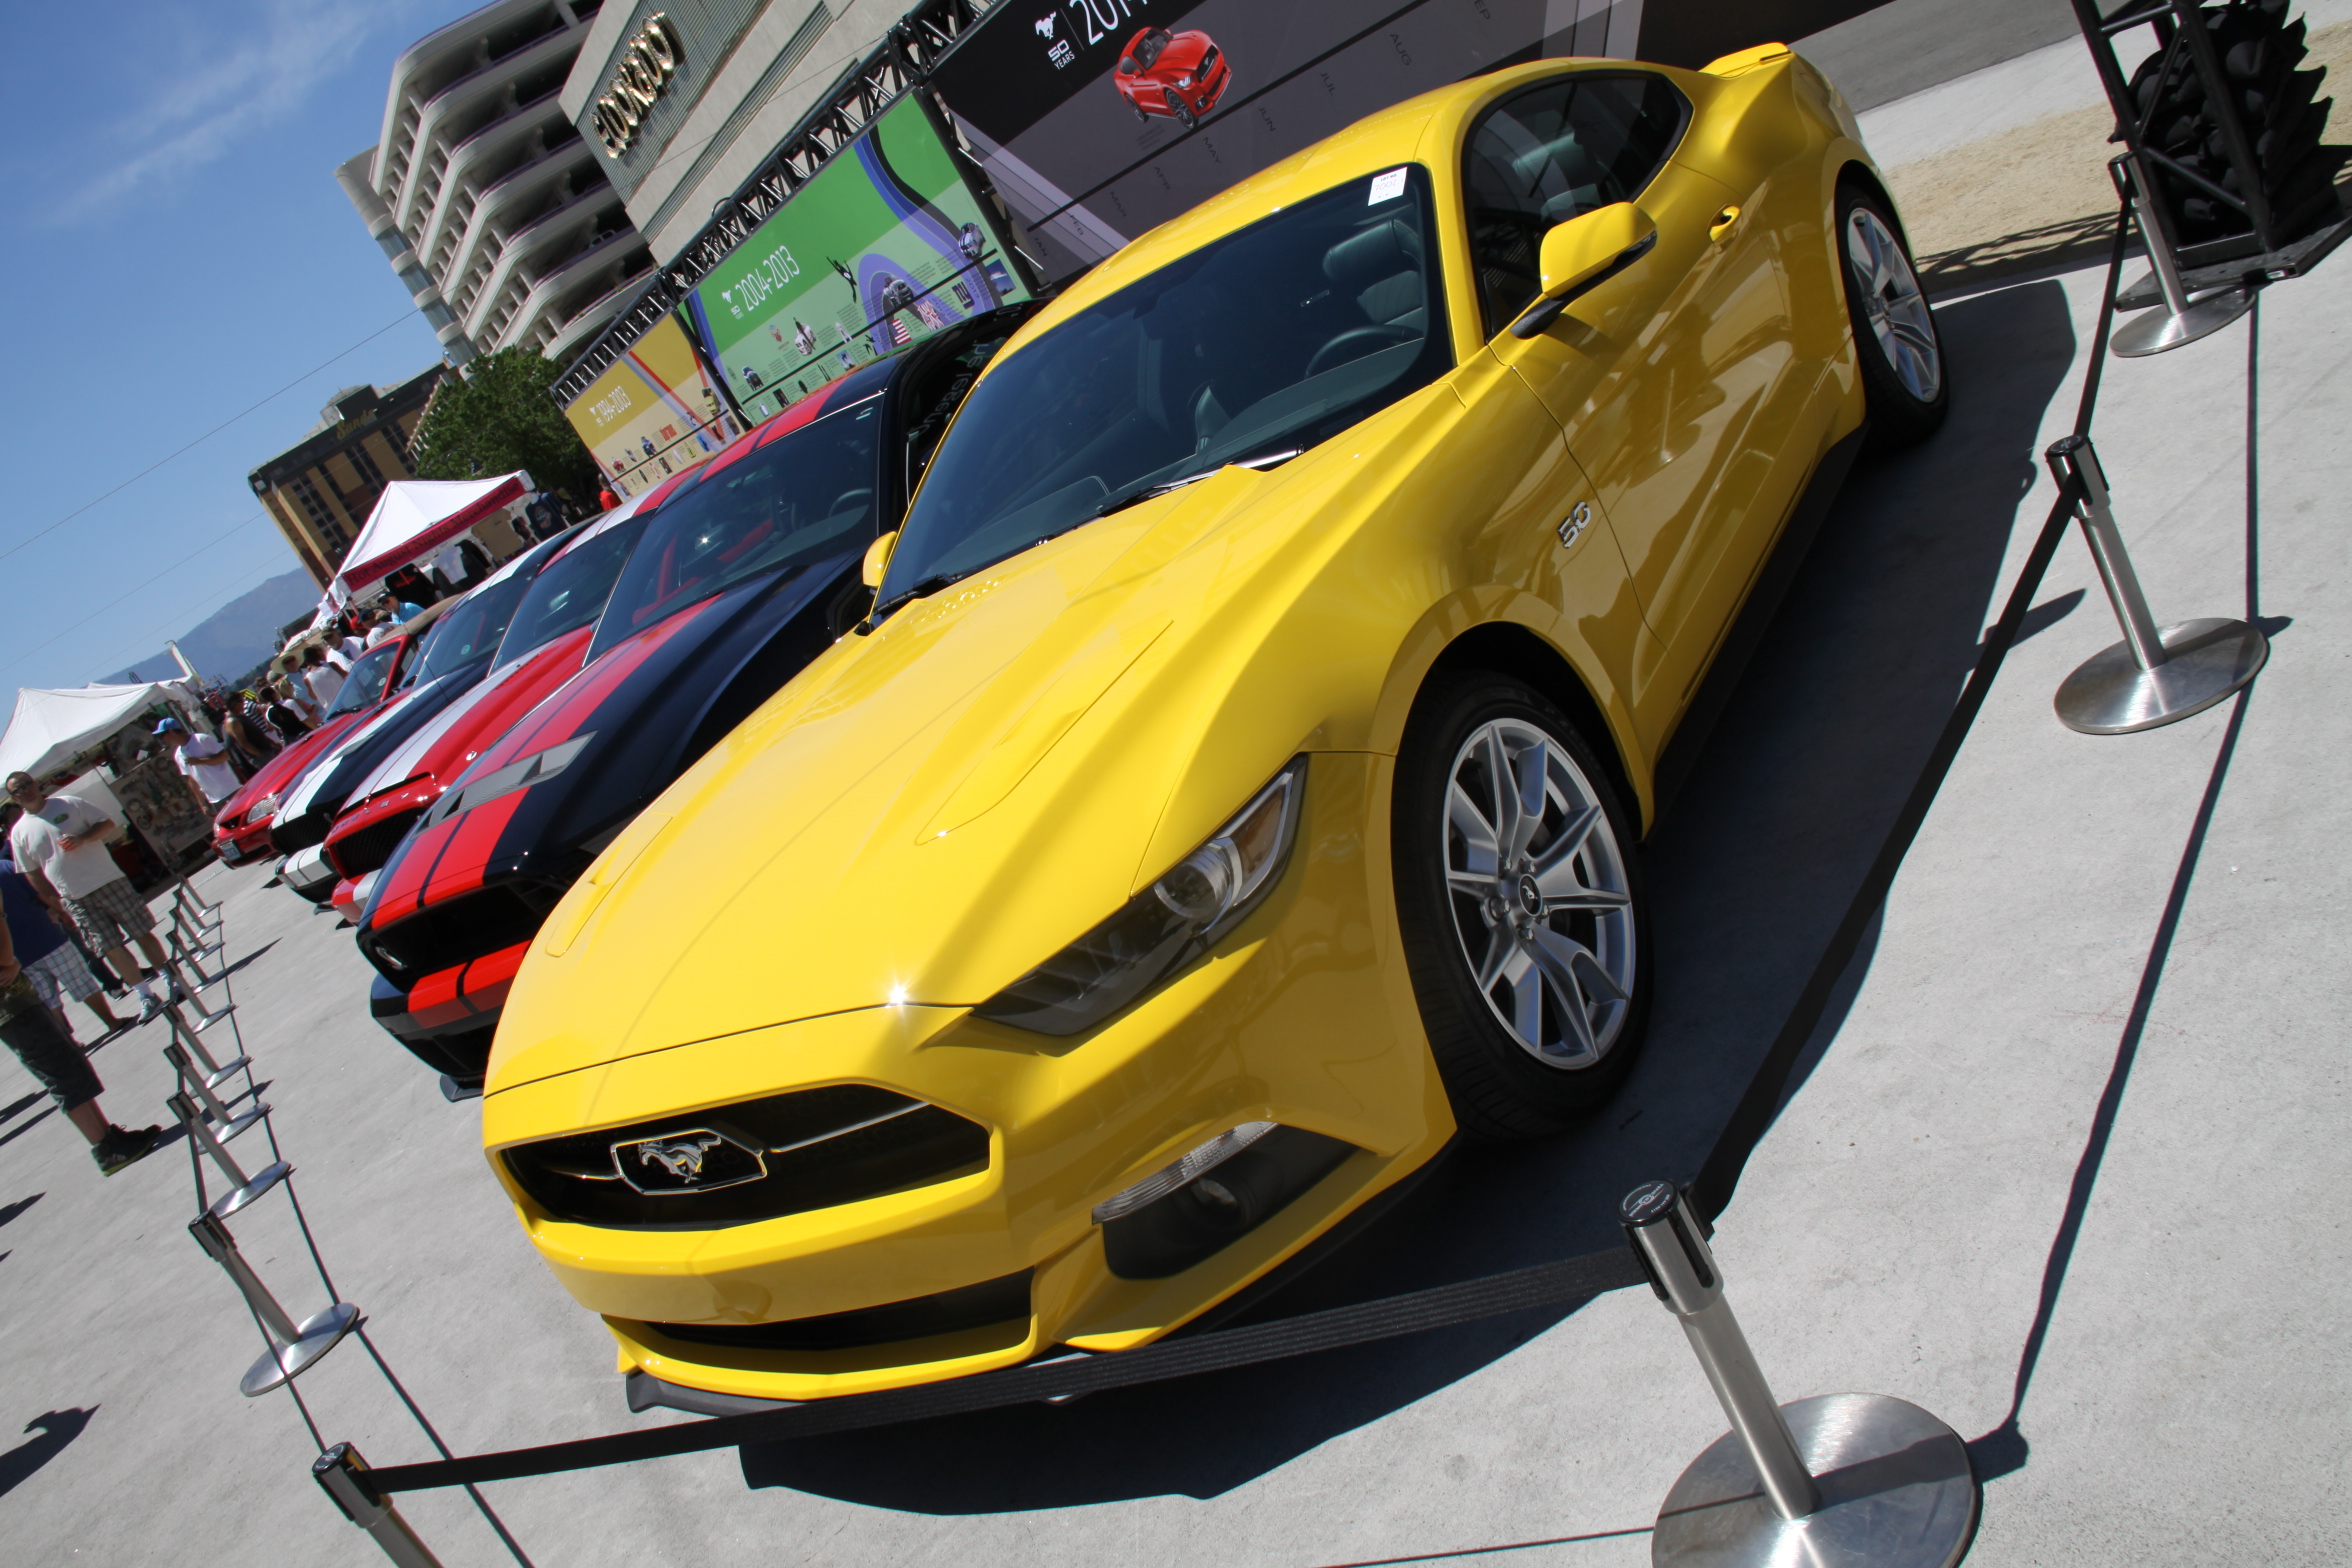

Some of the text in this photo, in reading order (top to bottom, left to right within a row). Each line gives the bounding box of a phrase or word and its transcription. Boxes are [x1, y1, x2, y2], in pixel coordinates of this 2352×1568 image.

[1047, 39, 1070, 62] 50
[1053, 50, 1075, 71] YEARS
[1389, 33, 1412, 66] AUG
[1320, 71, 1337, 96] JUL
[1257, 105, 1277, 132] JUN
[1202, 136, 1223, 164] MAY
[1153, 165, 1171, 191] APR
[734, 245, 800, 312] 2004-2013
[595, 385, 632, 422] 1994-2003
[336, 409, 376, 440] Sands
[346, 481, 521, 585] Hot August Nights Merchandise
